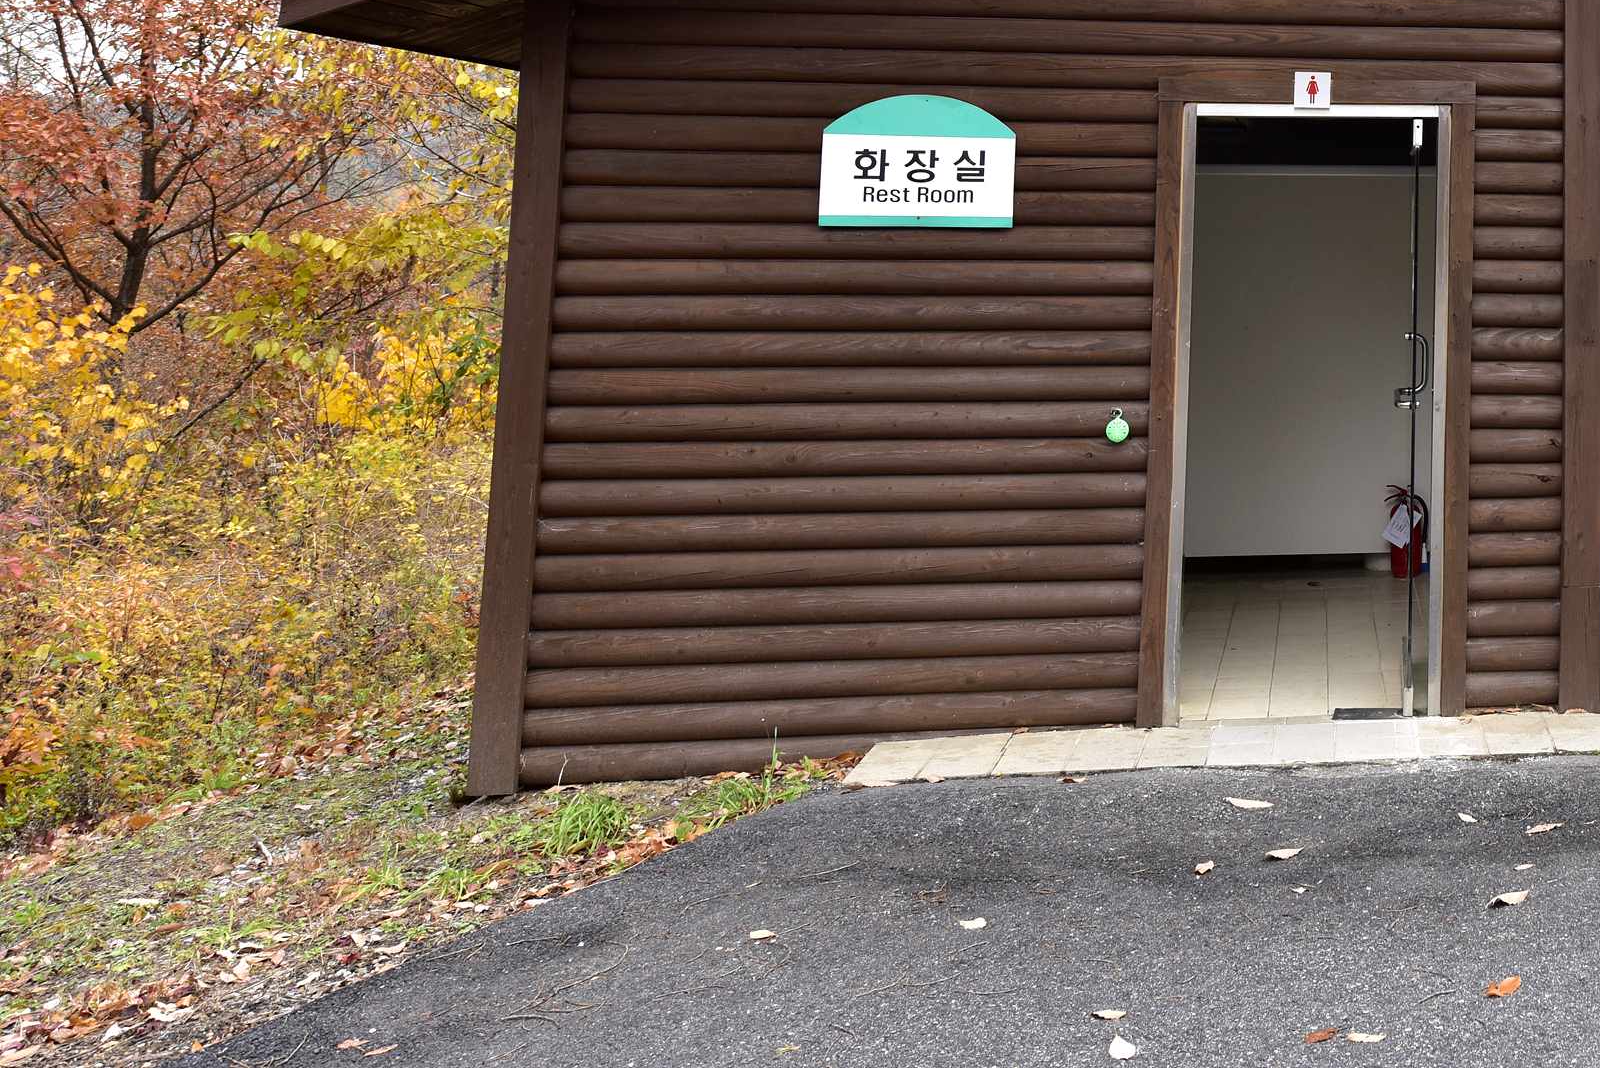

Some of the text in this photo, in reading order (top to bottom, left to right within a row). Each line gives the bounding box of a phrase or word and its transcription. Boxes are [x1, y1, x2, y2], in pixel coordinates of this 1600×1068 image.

[853, 149, 986, 183] 화장실
[863, 186, 974, 203] Rest Room
